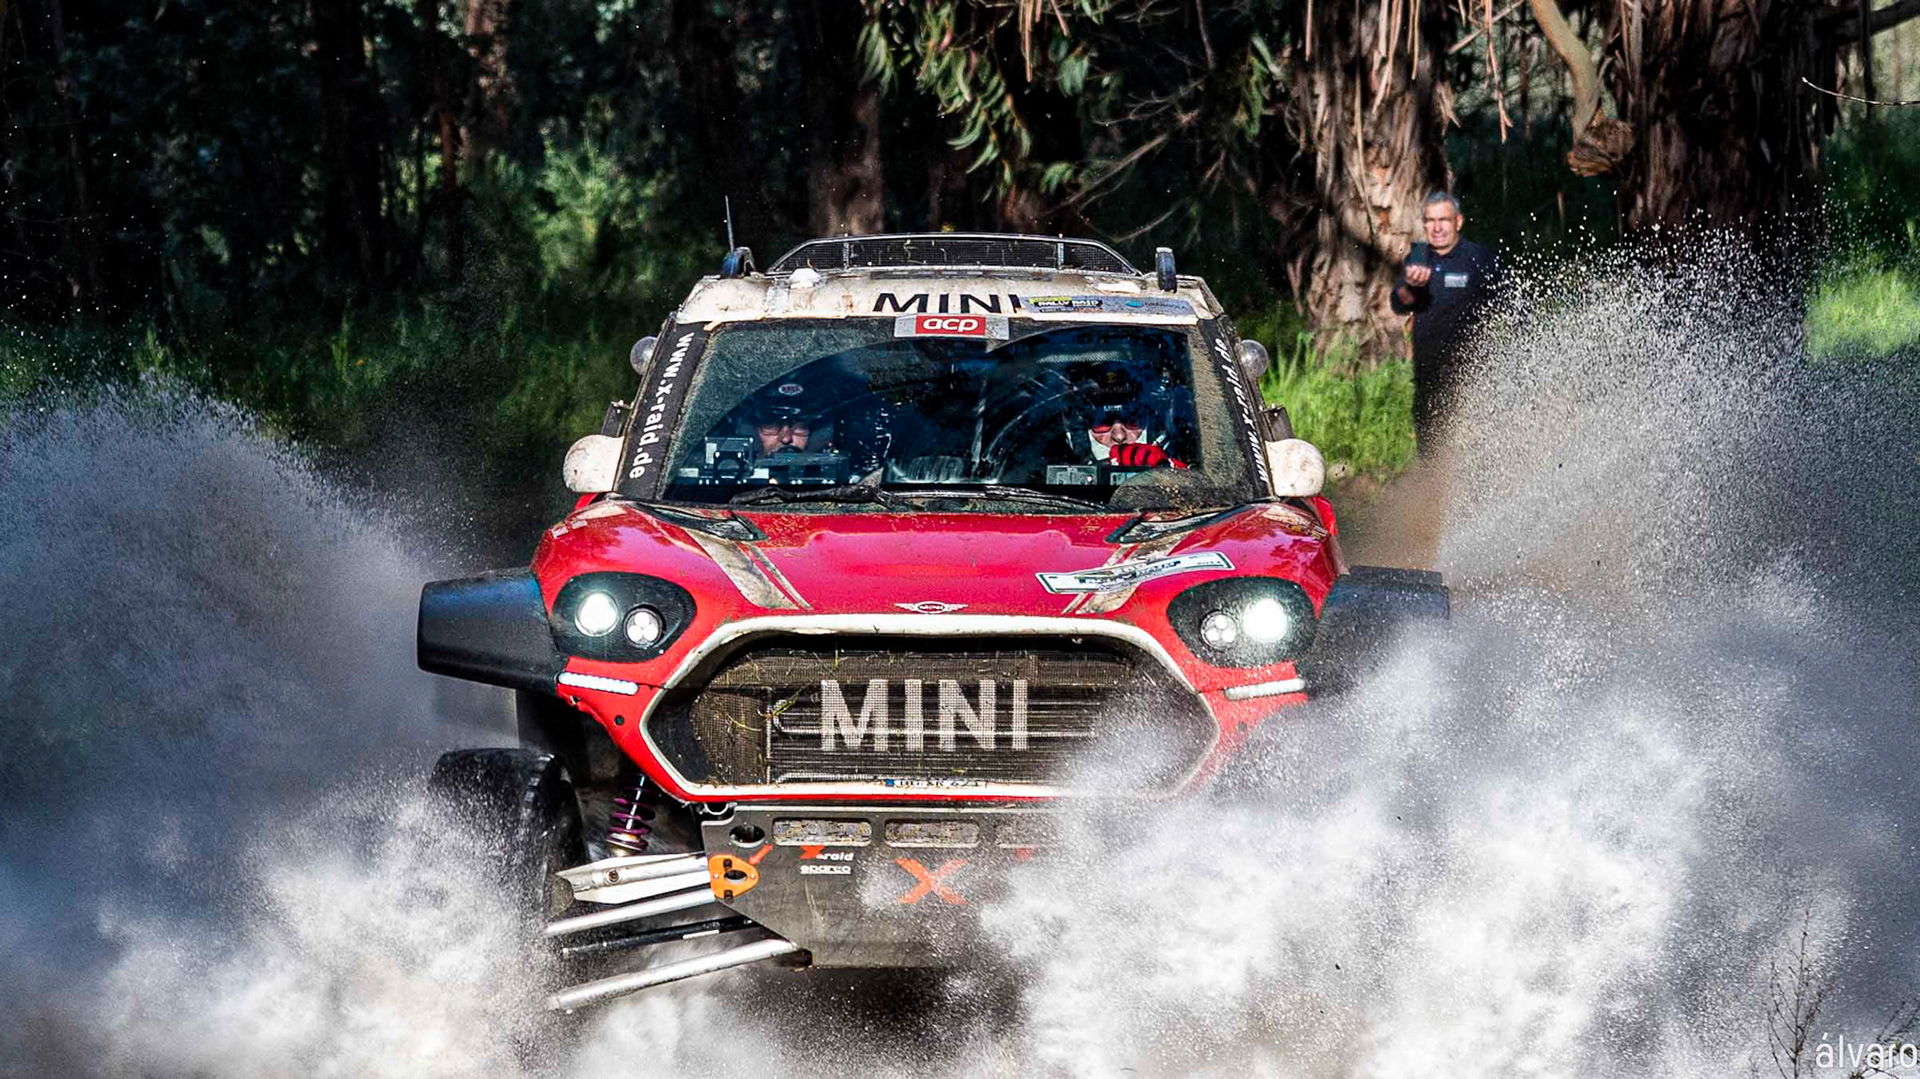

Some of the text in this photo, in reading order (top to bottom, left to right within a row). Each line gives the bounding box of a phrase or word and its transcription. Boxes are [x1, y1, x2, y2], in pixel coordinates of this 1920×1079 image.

[922, 318, 979, 333] acp
[629, 332, 695, 479] www.x-raid.de
[821, 679, 1028, 752] MINI
